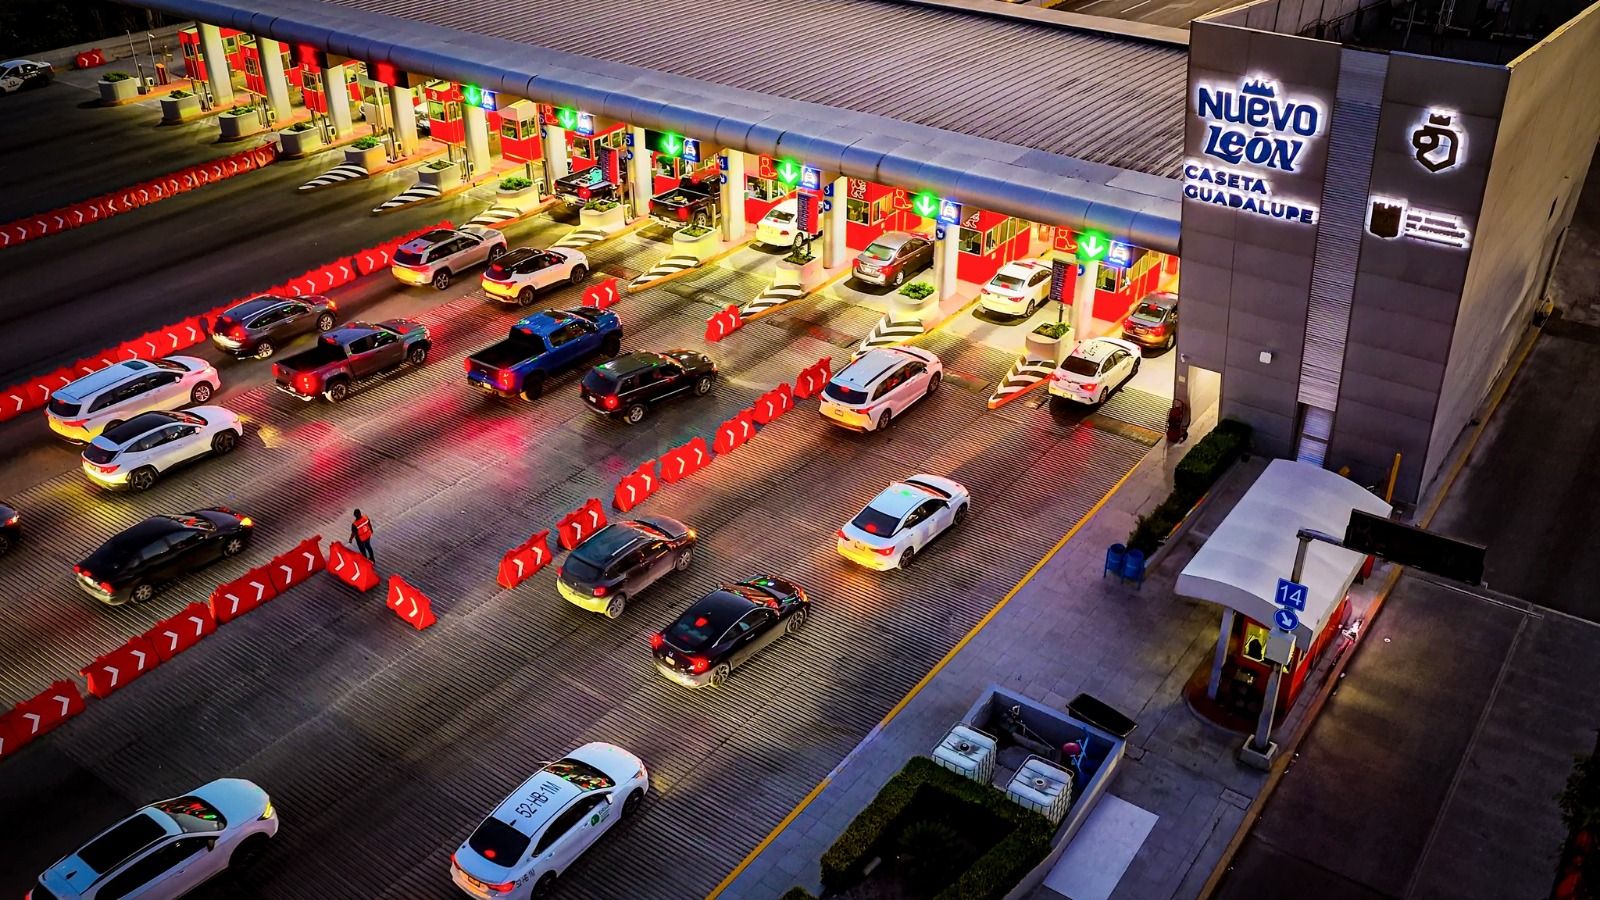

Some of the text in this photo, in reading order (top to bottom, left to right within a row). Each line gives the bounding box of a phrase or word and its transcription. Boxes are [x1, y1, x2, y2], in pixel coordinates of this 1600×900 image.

[1184, 164, 1267, 195] CASETA
[1184, 184, 1314, 225] GUADALUPE
[1280, 584, 1303, 607] 14
[515, 780, 562, 819] 52-HB-1M
